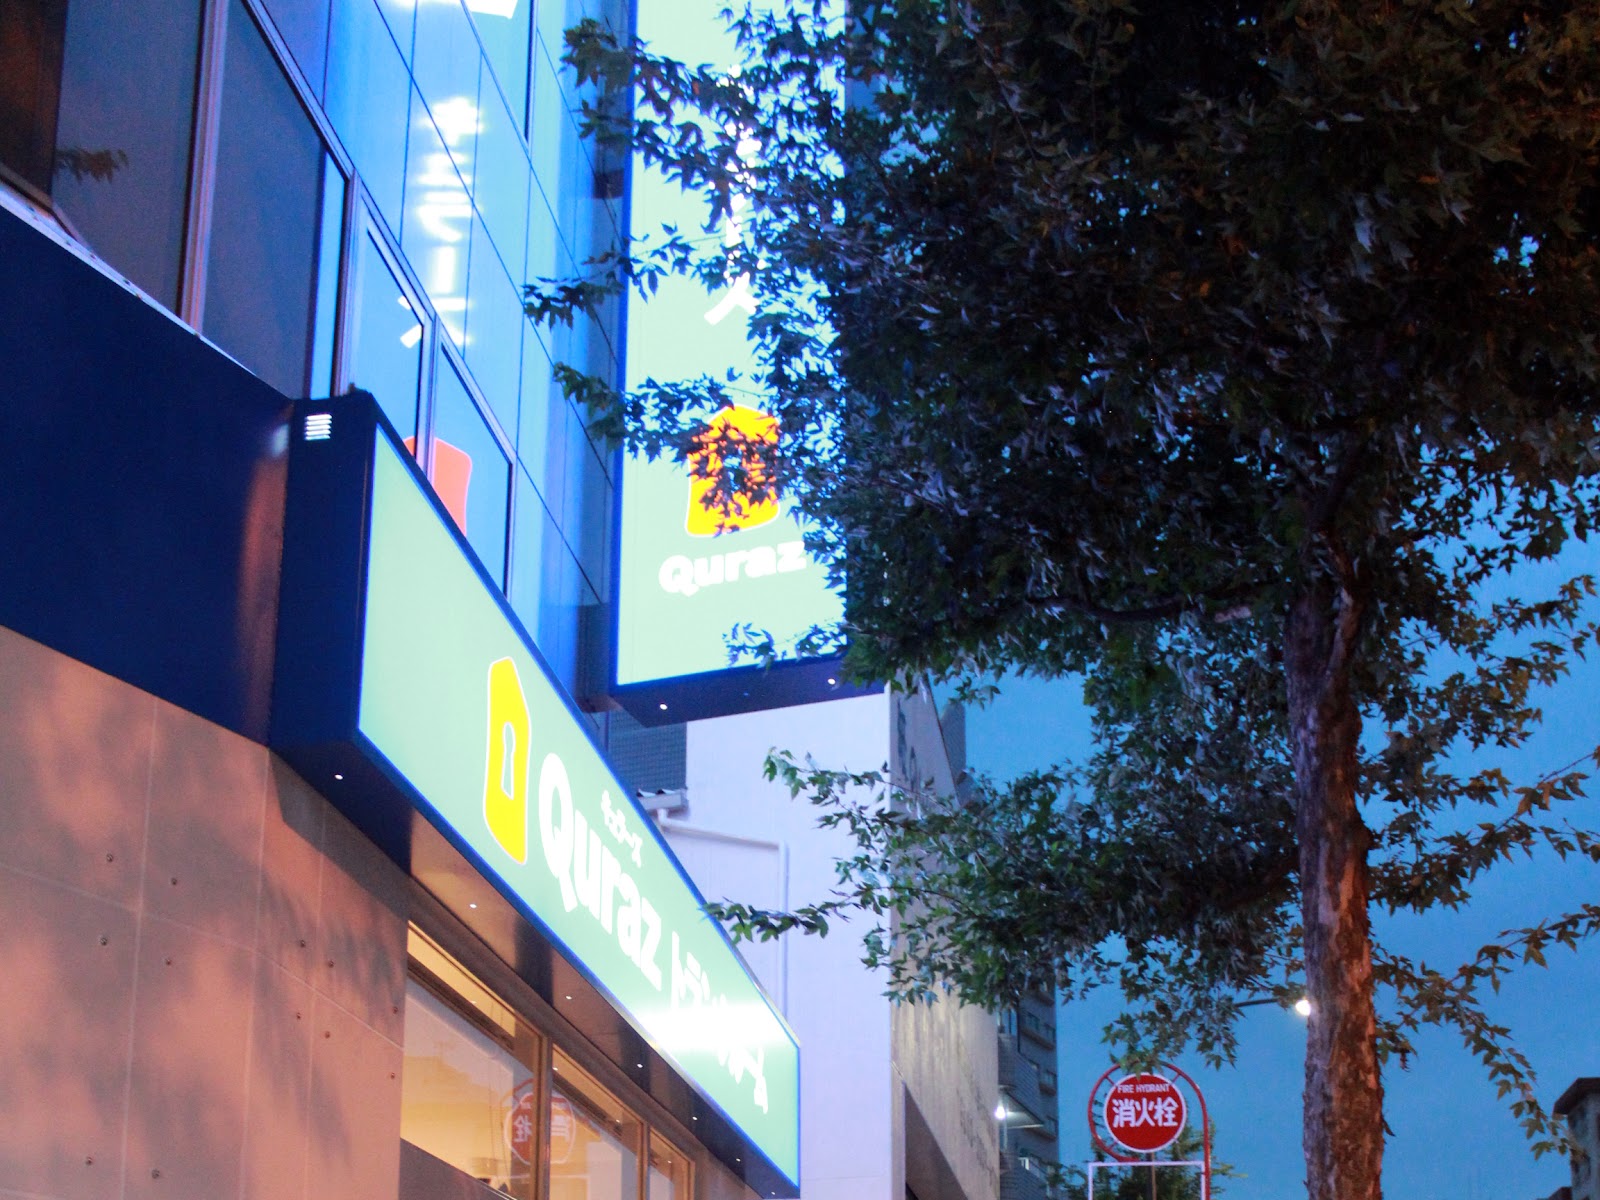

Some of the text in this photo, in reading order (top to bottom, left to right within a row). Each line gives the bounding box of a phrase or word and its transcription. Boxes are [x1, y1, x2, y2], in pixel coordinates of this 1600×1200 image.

[658, 540, 807, 597] Quraz
[538, 752, 662, 992] Quraz
[671, 931, 769, 1115] トラーム
[1117, 1083, 1171, 1094] FIRE HYDRANT
[1112, 1096, 1178, 1129] 消火栓
